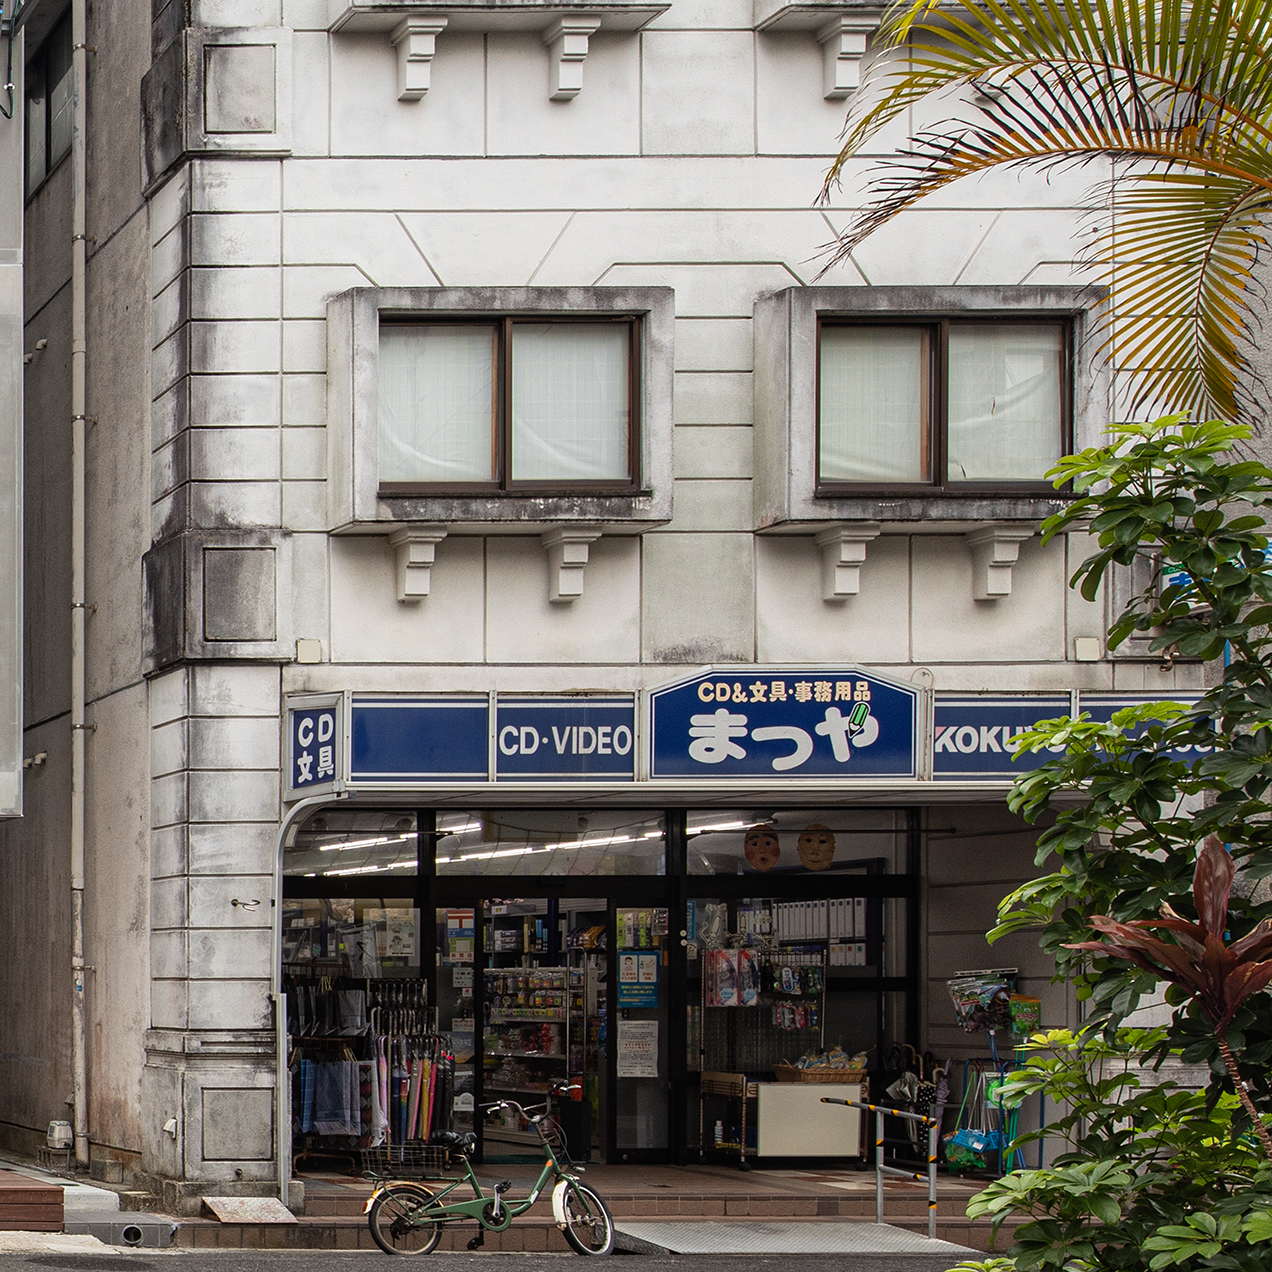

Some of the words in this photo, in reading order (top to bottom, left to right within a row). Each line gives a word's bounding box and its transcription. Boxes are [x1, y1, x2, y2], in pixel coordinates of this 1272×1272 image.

[298, 713, 334, 748] CD
[688, 706, 880, 771] まつや
[934, 725, 1068, 753] KOKU
[297, 746, 334, 783] 文具
